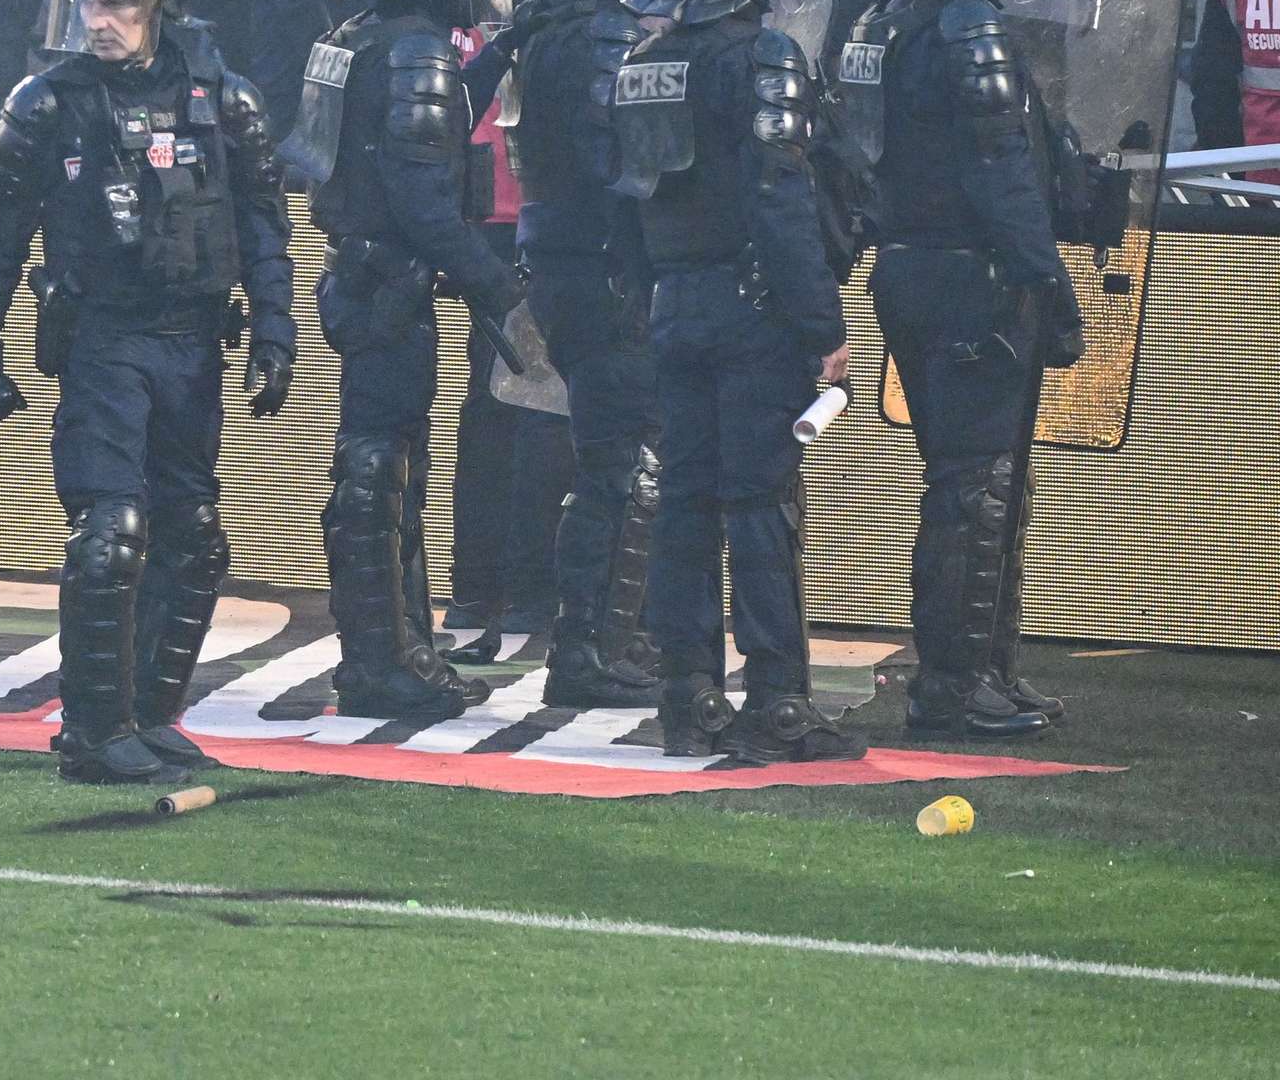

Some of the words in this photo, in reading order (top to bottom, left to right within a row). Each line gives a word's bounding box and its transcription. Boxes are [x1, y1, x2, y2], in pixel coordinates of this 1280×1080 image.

[843, 46, 877, 80] CRS
[623, 65, 682, 99] CRS
[150, 145, 174, 157] CRS
